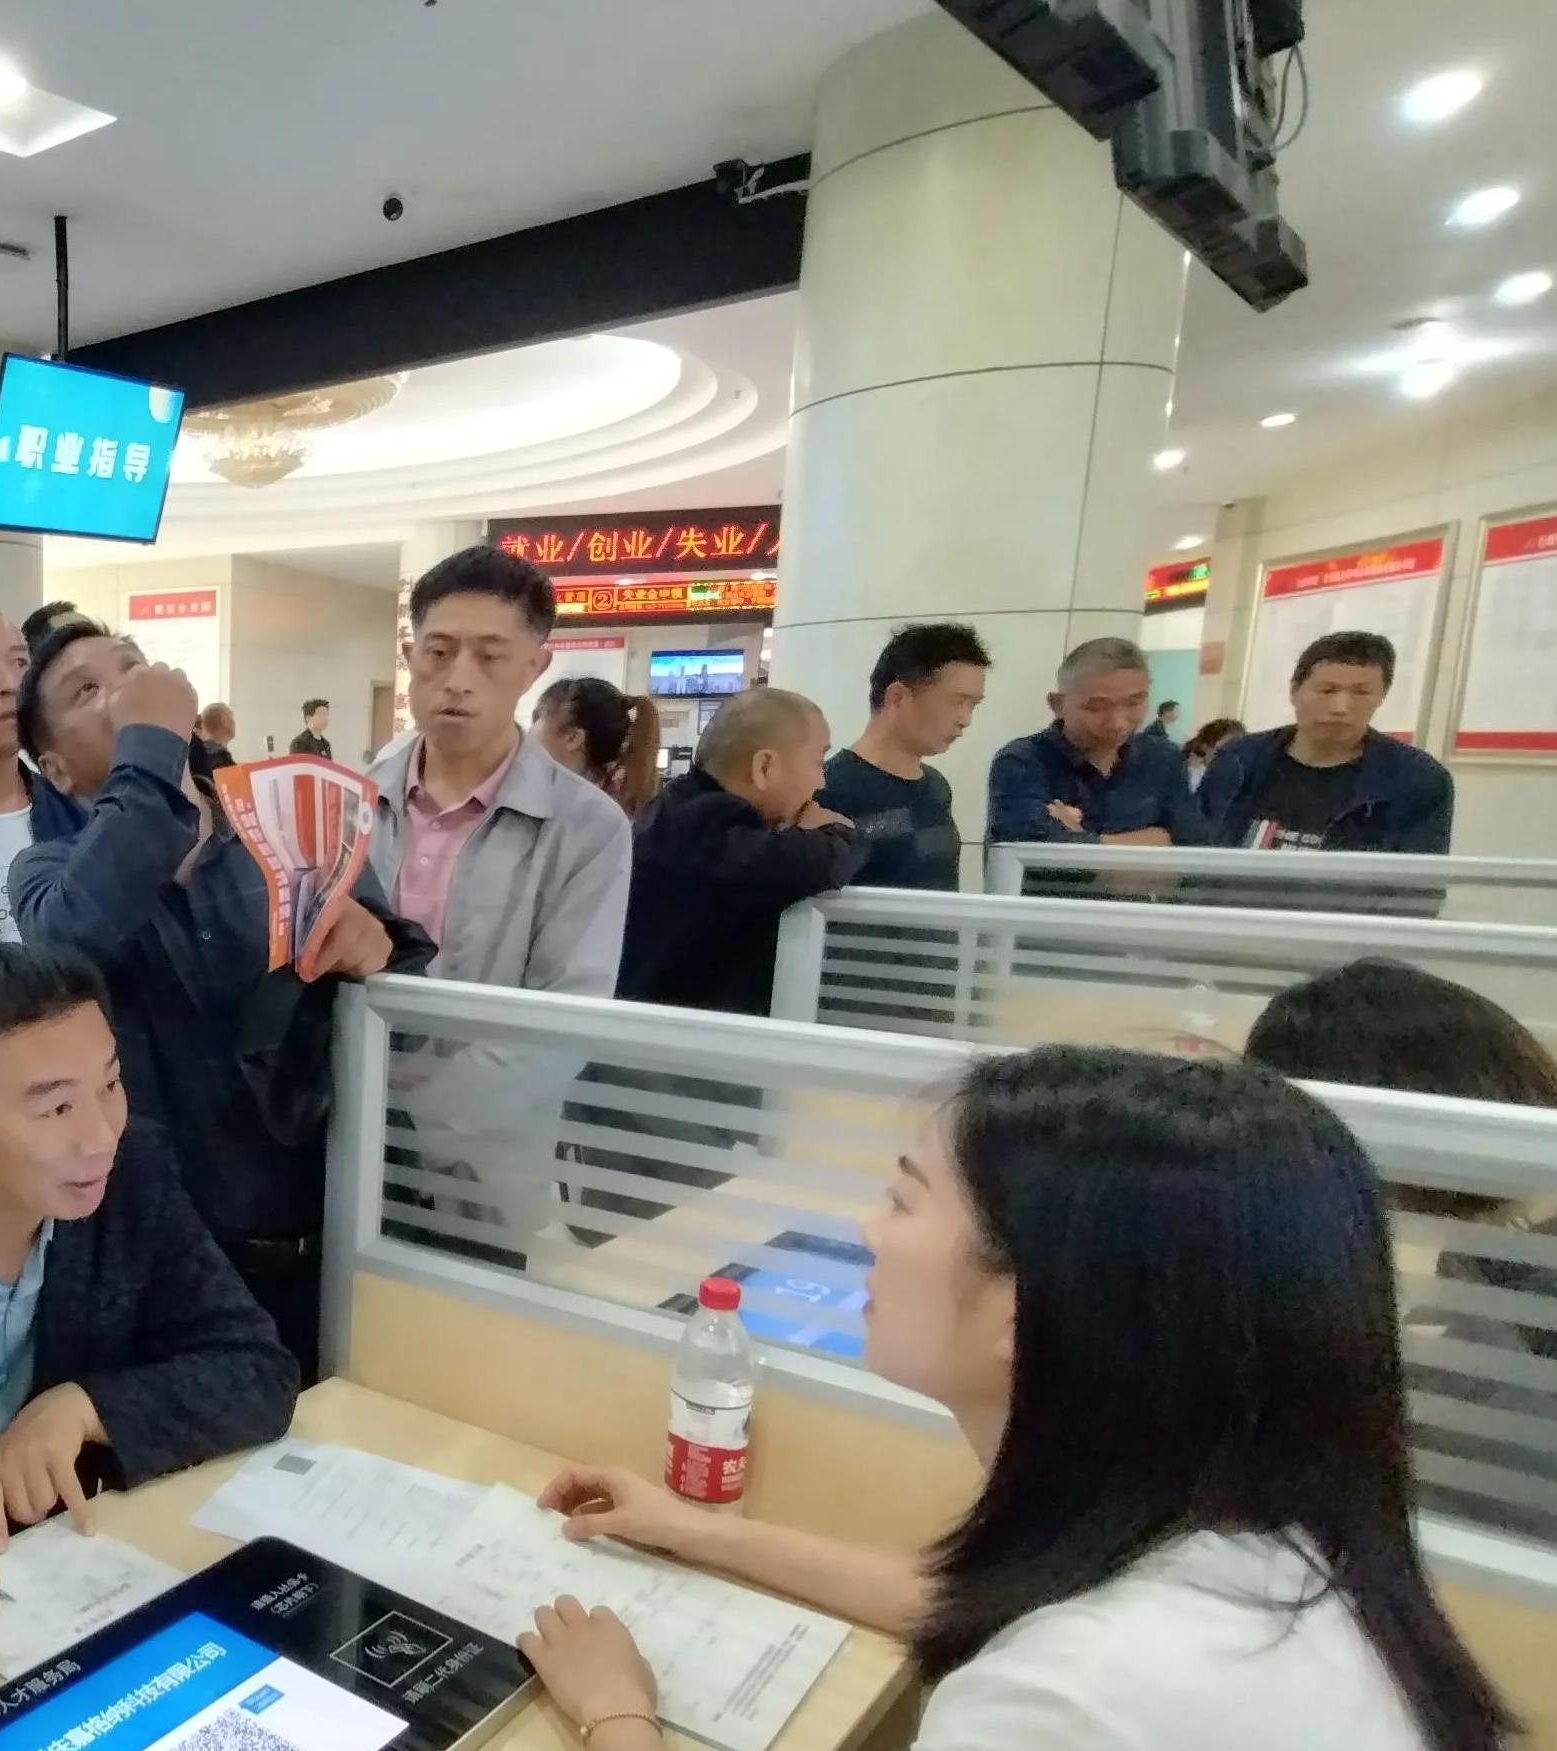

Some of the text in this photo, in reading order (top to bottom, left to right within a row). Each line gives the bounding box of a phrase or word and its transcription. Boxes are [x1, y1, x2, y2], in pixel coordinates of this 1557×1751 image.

[15, 424, 151, 484] 职业指导
[500, 523, 780, 563] 就业/创业/失业/
[32, 1640, 228, 1751] 庆嘉格纳科技有限公司
